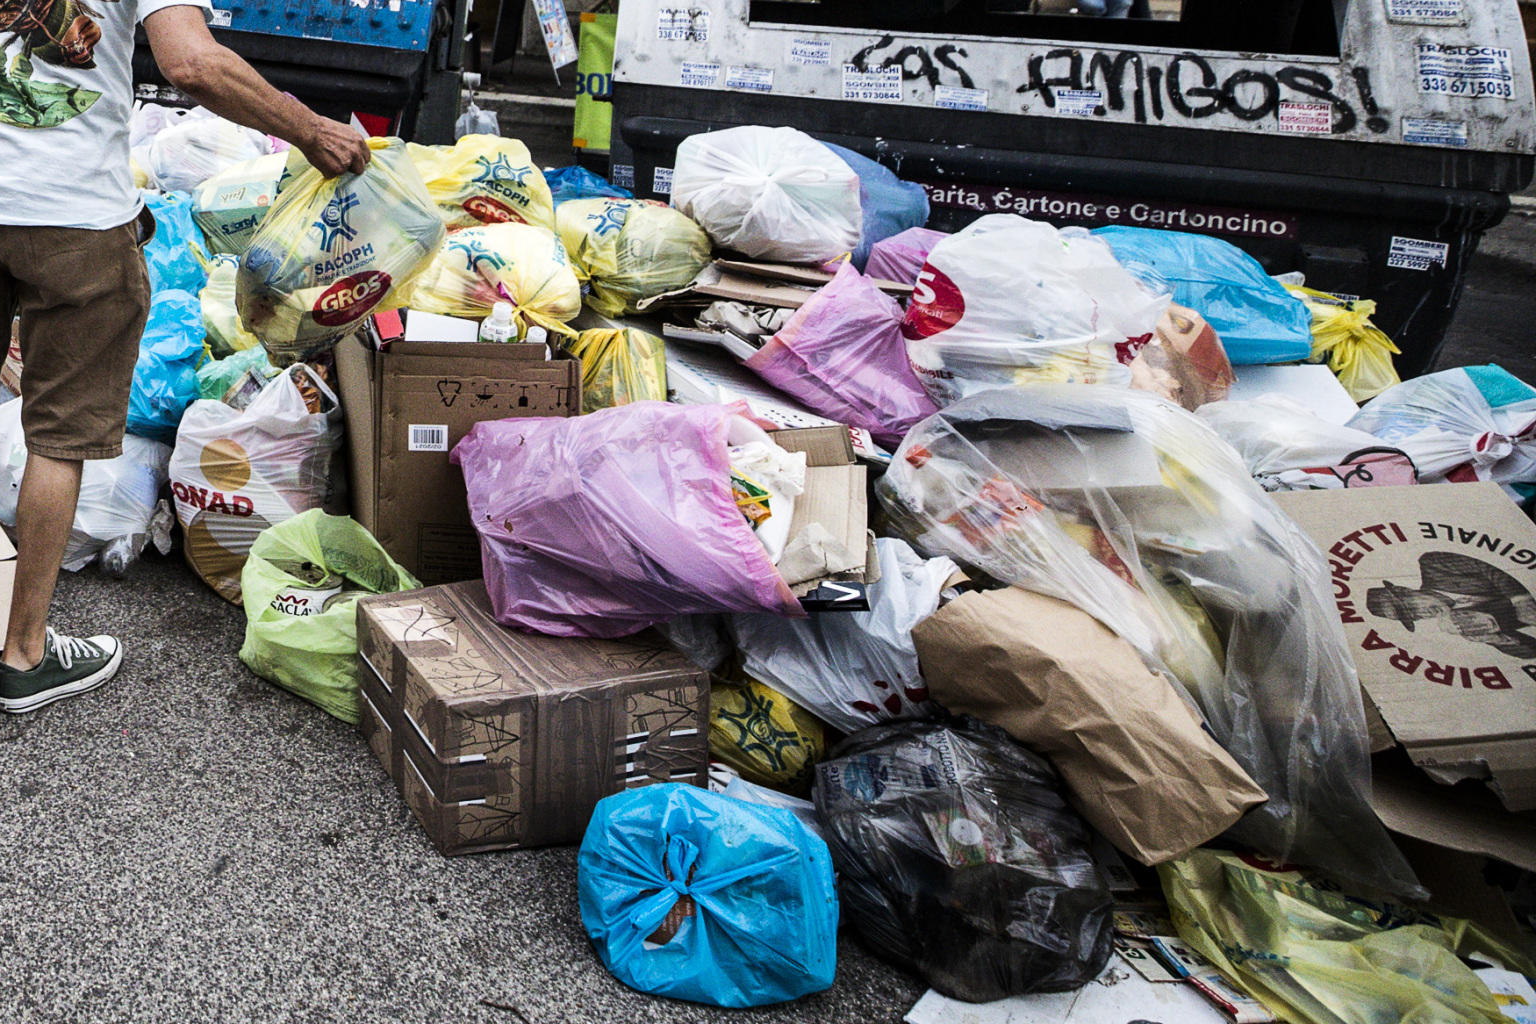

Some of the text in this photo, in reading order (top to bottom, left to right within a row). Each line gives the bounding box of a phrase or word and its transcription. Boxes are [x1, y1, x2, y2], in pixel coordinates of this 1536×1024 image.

[1417, 44, 1508, 58] TRASLOCHI
[1422, 77, 1511, 97] 338 6715053
[1279, 102, 1330, 112] TRASLOCHI
[481, 179, 531, 207] ACOPH
[994, 187, 1096, 217] Cartone
[1106, 204, 1121, 220] e
[1129, 202, 1288, 236] Cartoncino
[314, 242, 374, 275] SACOPH
[320, 274, 382, 313] GROS
[168, 478, 254, 517] ONAD
[1361, 628, 1513, 690] BIRRA
